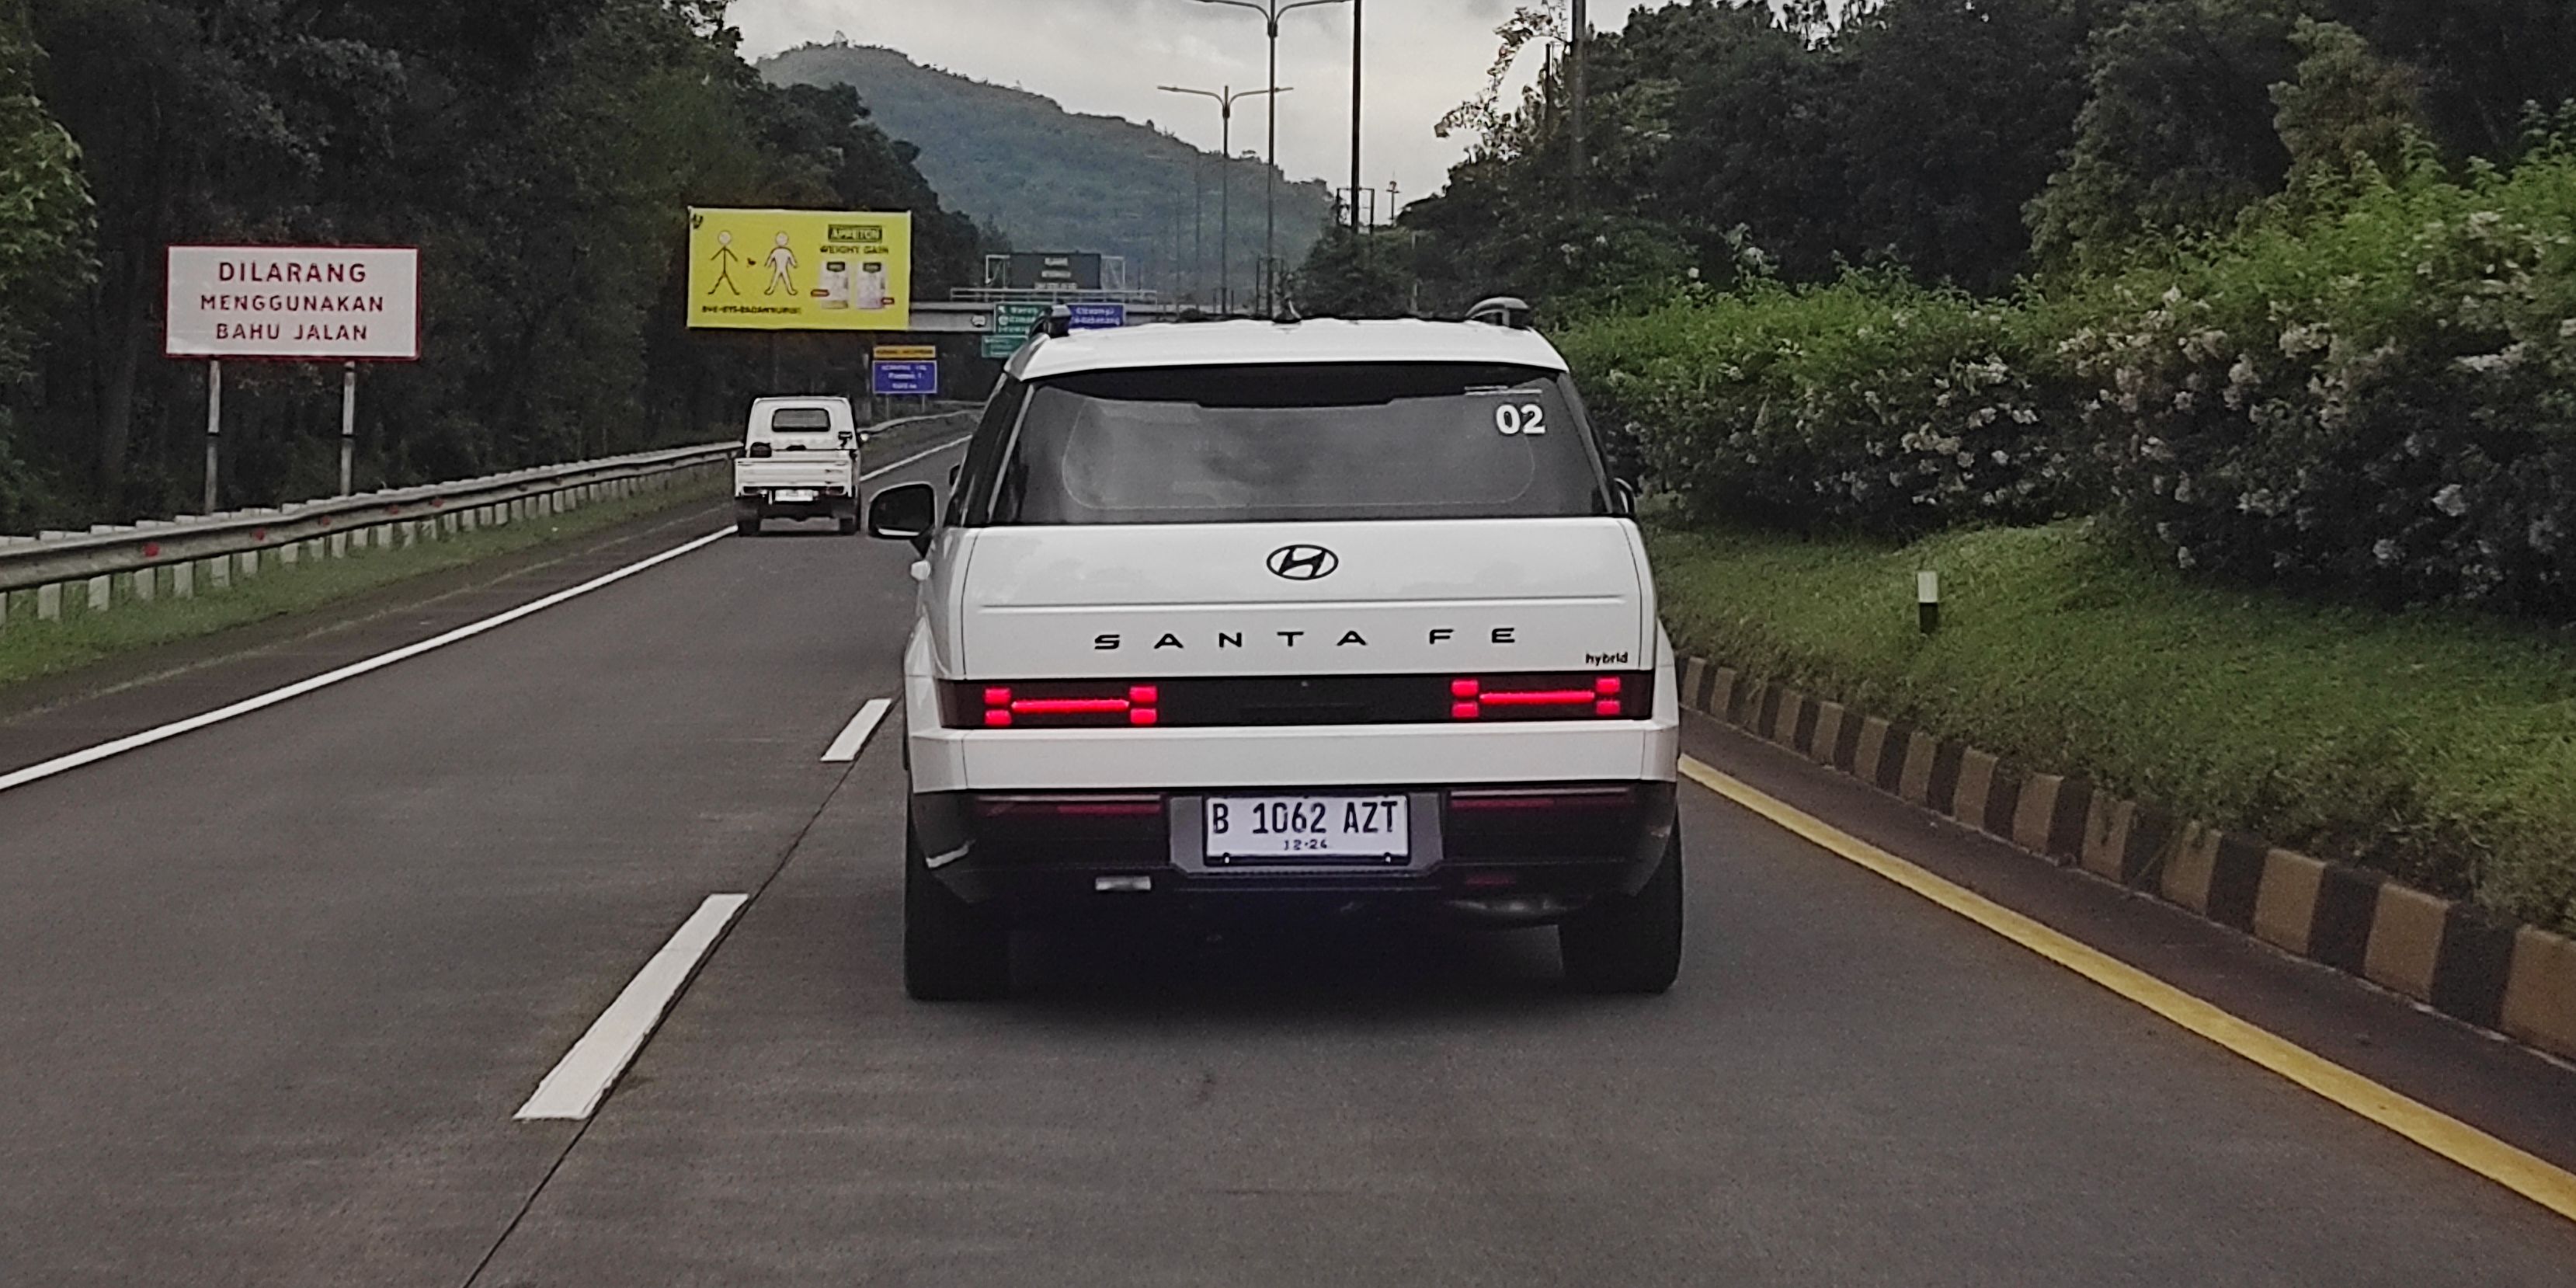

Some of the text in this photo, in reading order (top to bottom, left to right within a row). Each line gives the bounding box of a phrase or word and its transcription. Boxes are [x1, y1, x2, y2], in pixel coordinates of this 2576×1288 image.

[218, 261, 367, 283] DILARANG
[200, 294, 384, 312] MENGGUNAKAN
[215, 323, 367, 340] BAHU JALAN
[1496, 404, 1545, 434] 02
[1093, 627, 1516, 650] SANTA FE
[1585, 651, 1629, 667] hybrid
[1212, 800, 1398, 834] B 1062 AZT
